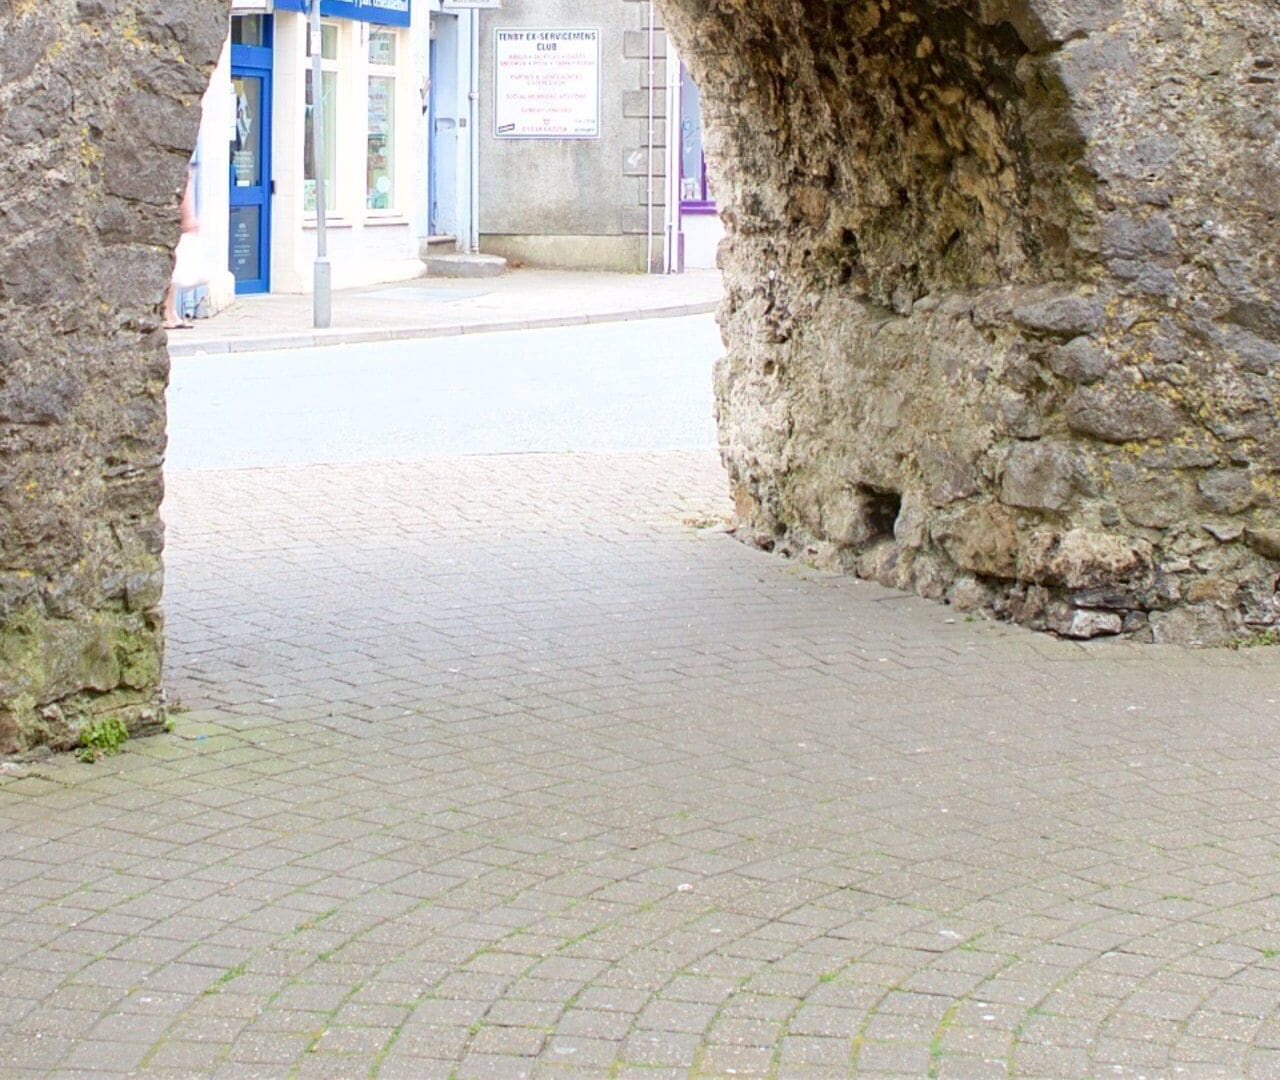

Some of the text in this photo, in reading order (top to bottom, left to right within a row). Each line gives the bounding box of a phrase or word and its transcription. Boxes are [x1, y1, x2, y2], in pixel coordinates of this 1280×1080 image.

[499, 32, 596, 41] TENBY EX-SERVICEMENS
[536, 42, 558, 51] CLUB
